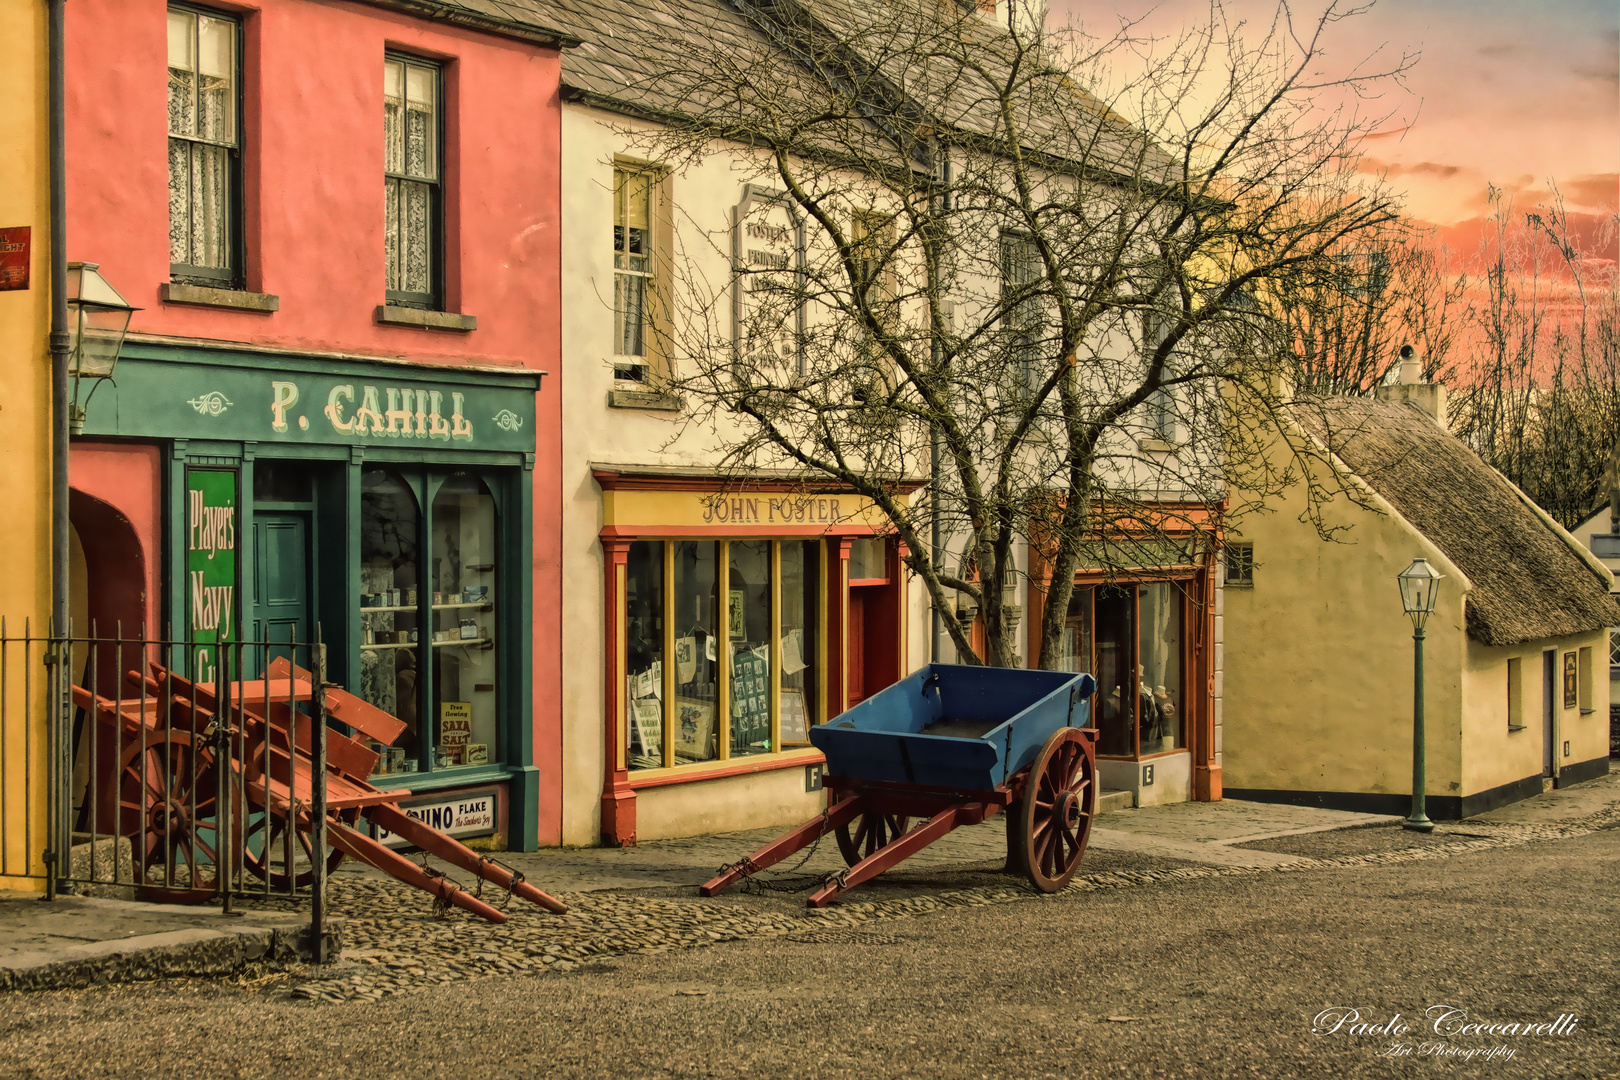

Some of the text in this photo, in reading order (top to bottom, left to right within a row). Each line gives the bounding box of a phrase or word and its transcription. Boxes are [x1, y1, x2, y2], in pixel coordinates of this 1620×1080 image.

[271, 381, 474, 442] P. CAHILL
[703, 498, 841, 523] JOHN FOSTER
[189, 489, 235, 560] Player's
[190, 570, 233, 639] Navy
[442, 720, 471, 733] SAXA
[442, 733, 471, 745] SALT
[811, 767, 818, 788] F
[459, 801, 486, 815] FLAKE
[455, 816, 463, 827] The
